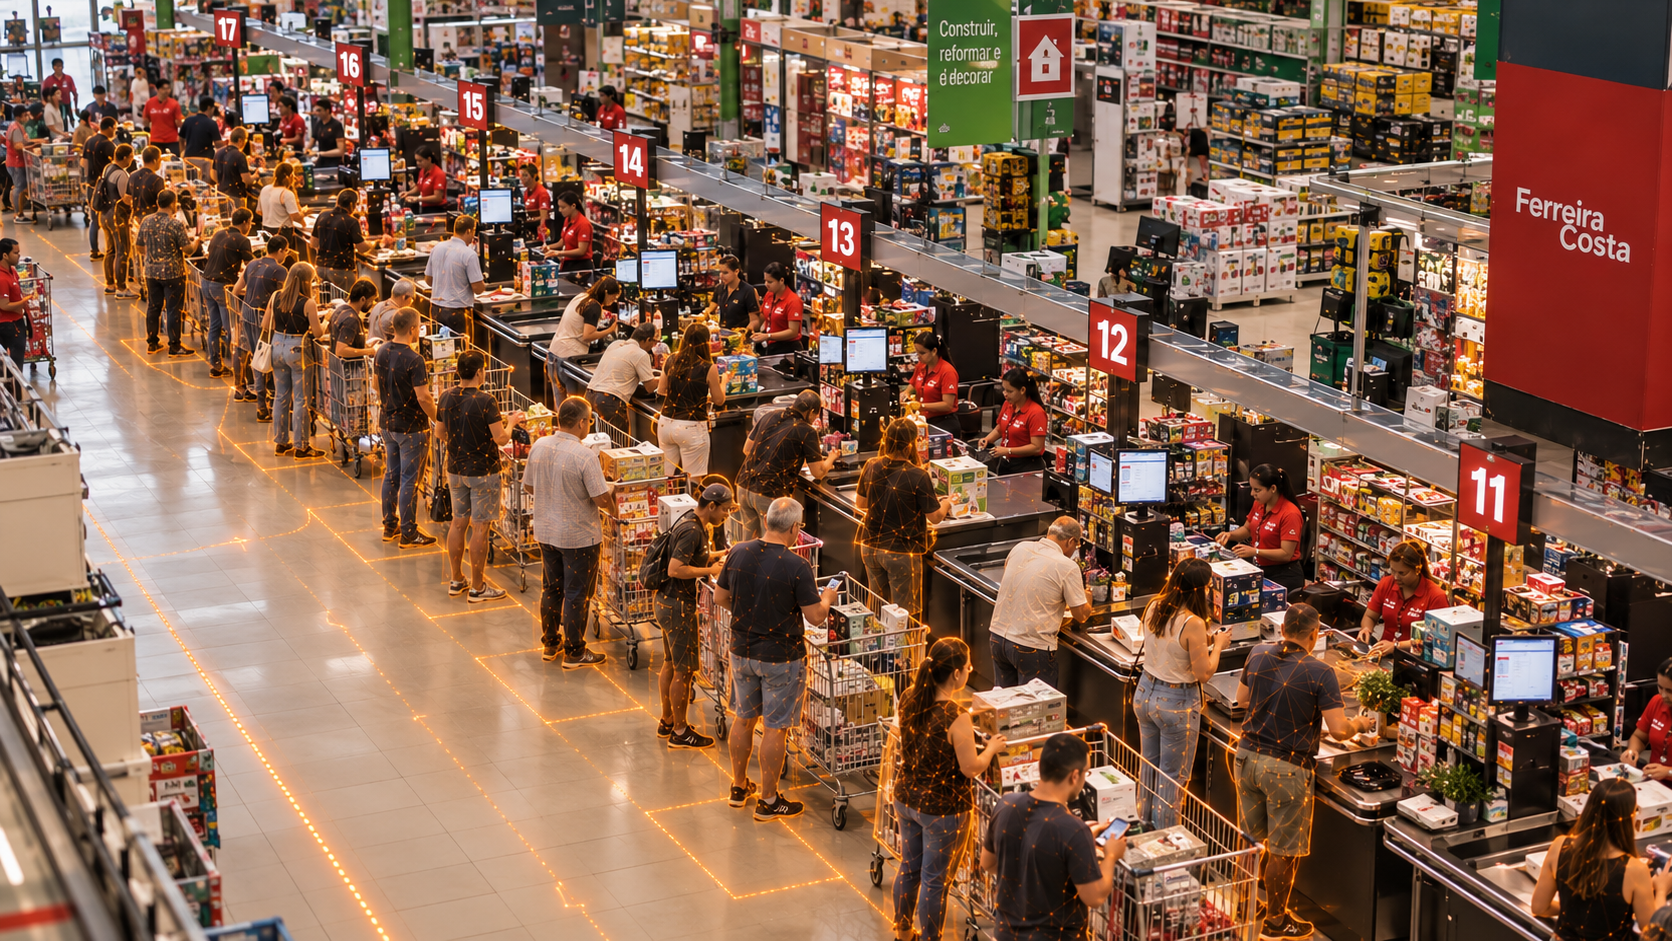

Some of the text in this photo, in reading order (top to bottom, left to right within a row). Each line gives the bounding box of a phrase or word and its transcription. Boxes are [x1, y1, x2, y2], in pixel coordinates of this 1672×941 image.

[217, 16, 237, 41] 17
[939, 19, 998, 38] Construir,
[339, 51, 360, 79] 16
[939, 44, 1002, 62] reformar e
[462, 90, 484, 121] 15
[618, 143, 644, 178] 14
[1515, 186, 1604, 232] Ferreira
[827, 218, 855, 257] 13
[1559, 224, 1631, 263] Costa
[1097, 319, 1129, 366] 12
[1470, 466, 1507, 524] 11
